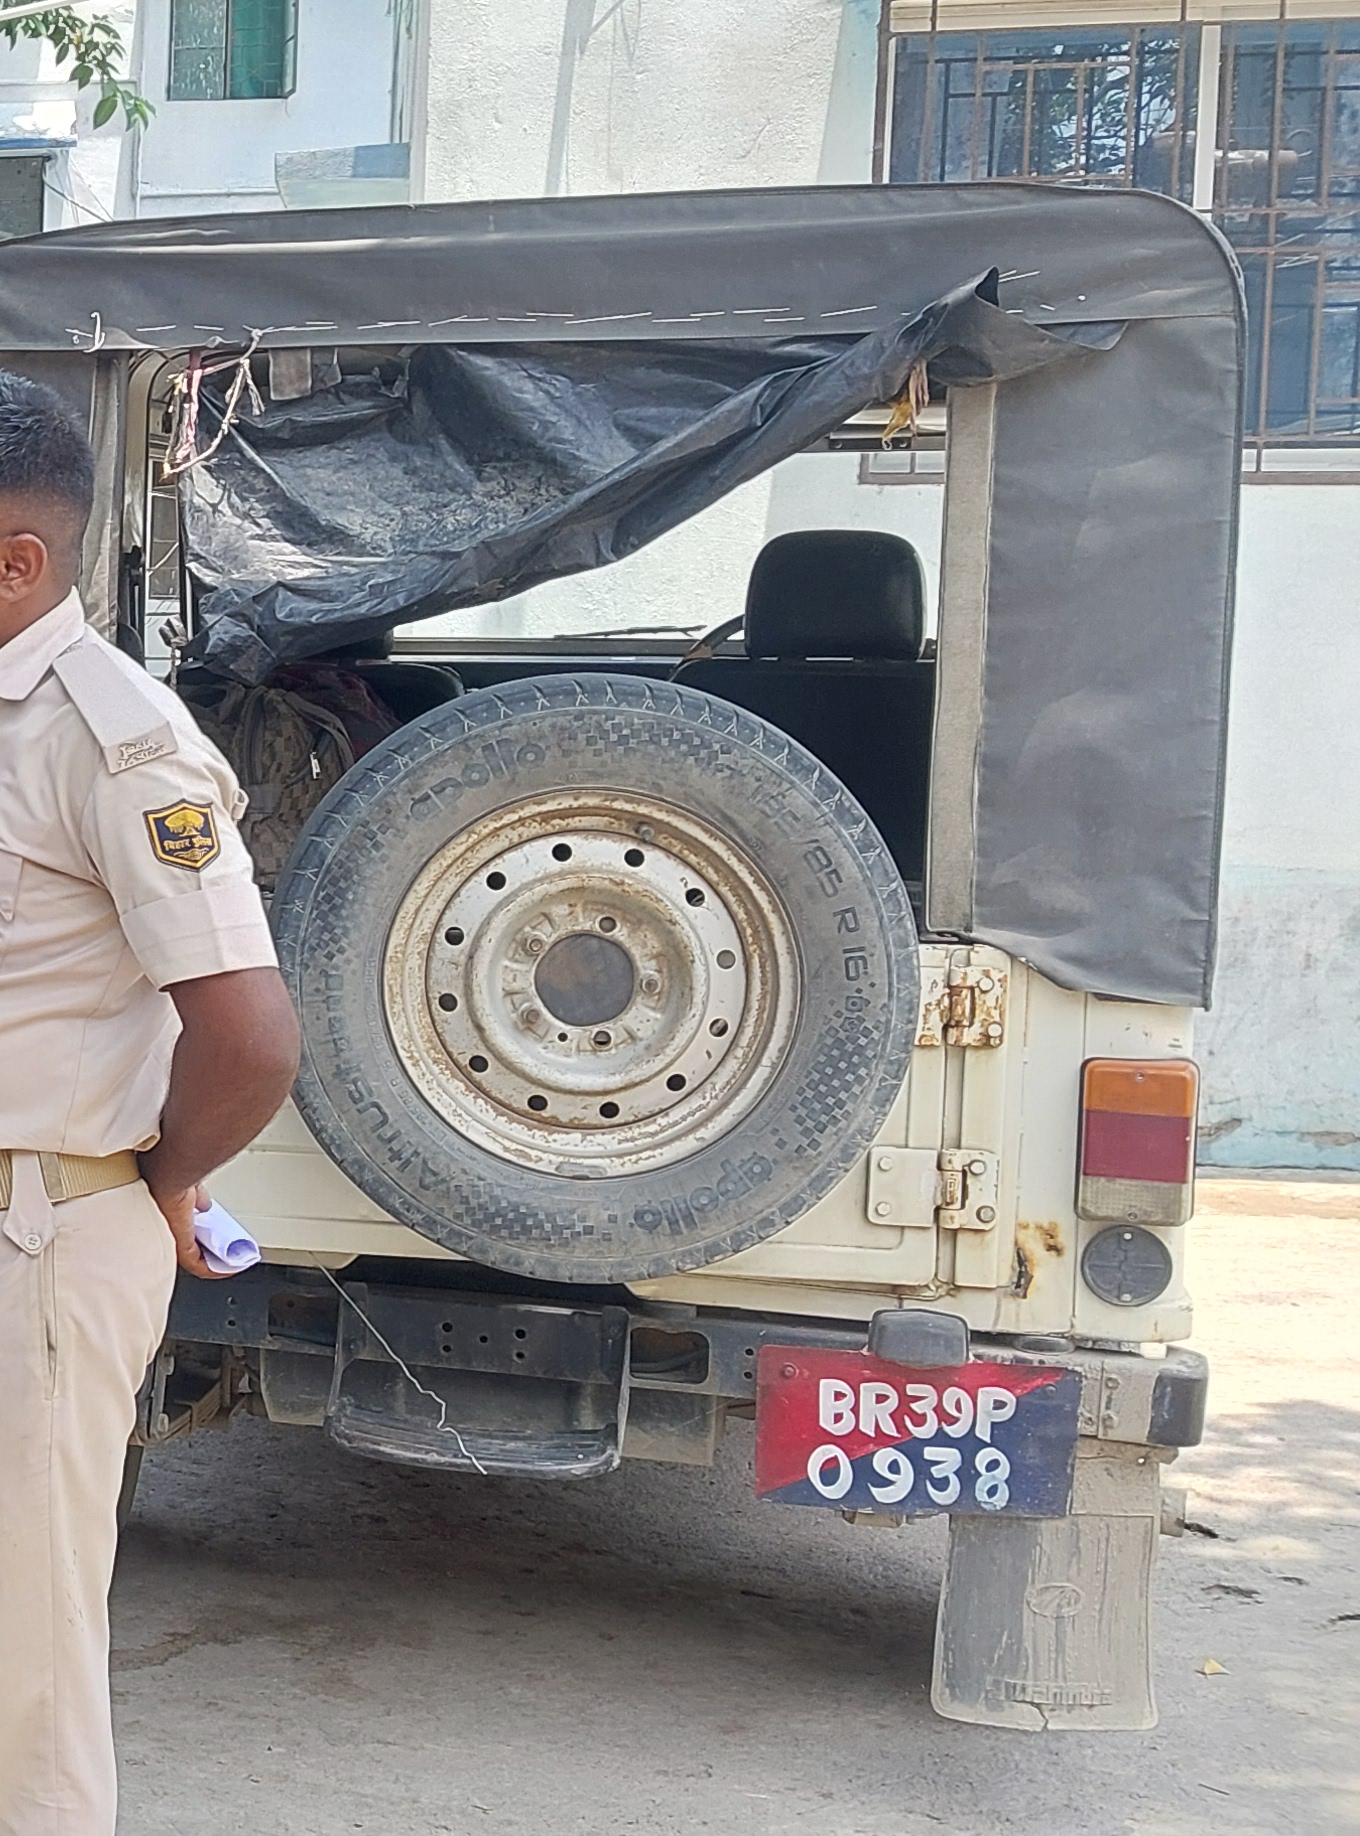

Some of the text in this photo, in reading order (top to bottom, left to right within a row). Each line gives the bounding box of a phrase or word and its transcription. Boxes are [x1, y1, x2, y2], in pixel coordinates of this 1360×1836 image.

[410, 738, 546, 822] apollo
[833, 906, 861, 935] R
[633, 1154, 773, 1236] apollo
[819, 1379, 1017, 1443] BR39P
[807, 1444, 1011, 1511] 0938
